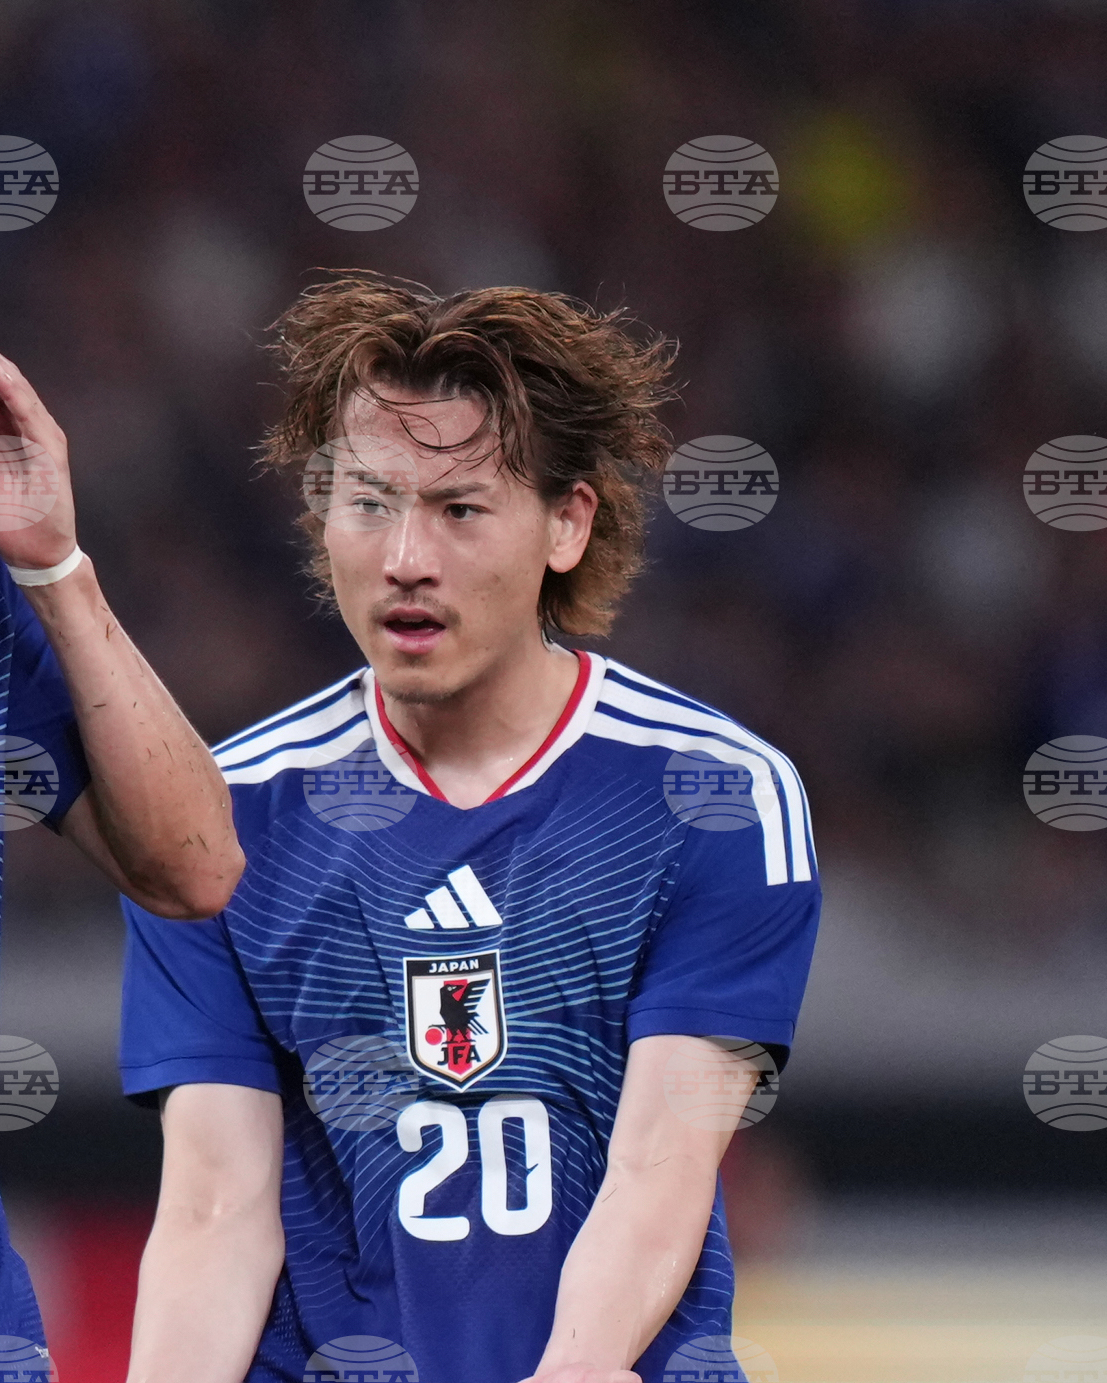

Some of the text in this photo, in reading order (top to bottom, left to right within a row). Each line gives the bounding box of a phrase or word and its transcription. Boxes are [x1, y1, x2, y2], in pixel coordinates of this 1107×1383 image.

[429, 959, 480, 973] JAPAN
[437, 1045, 482, 1066] JFA
[396, 1094, 553, 1241] 20
